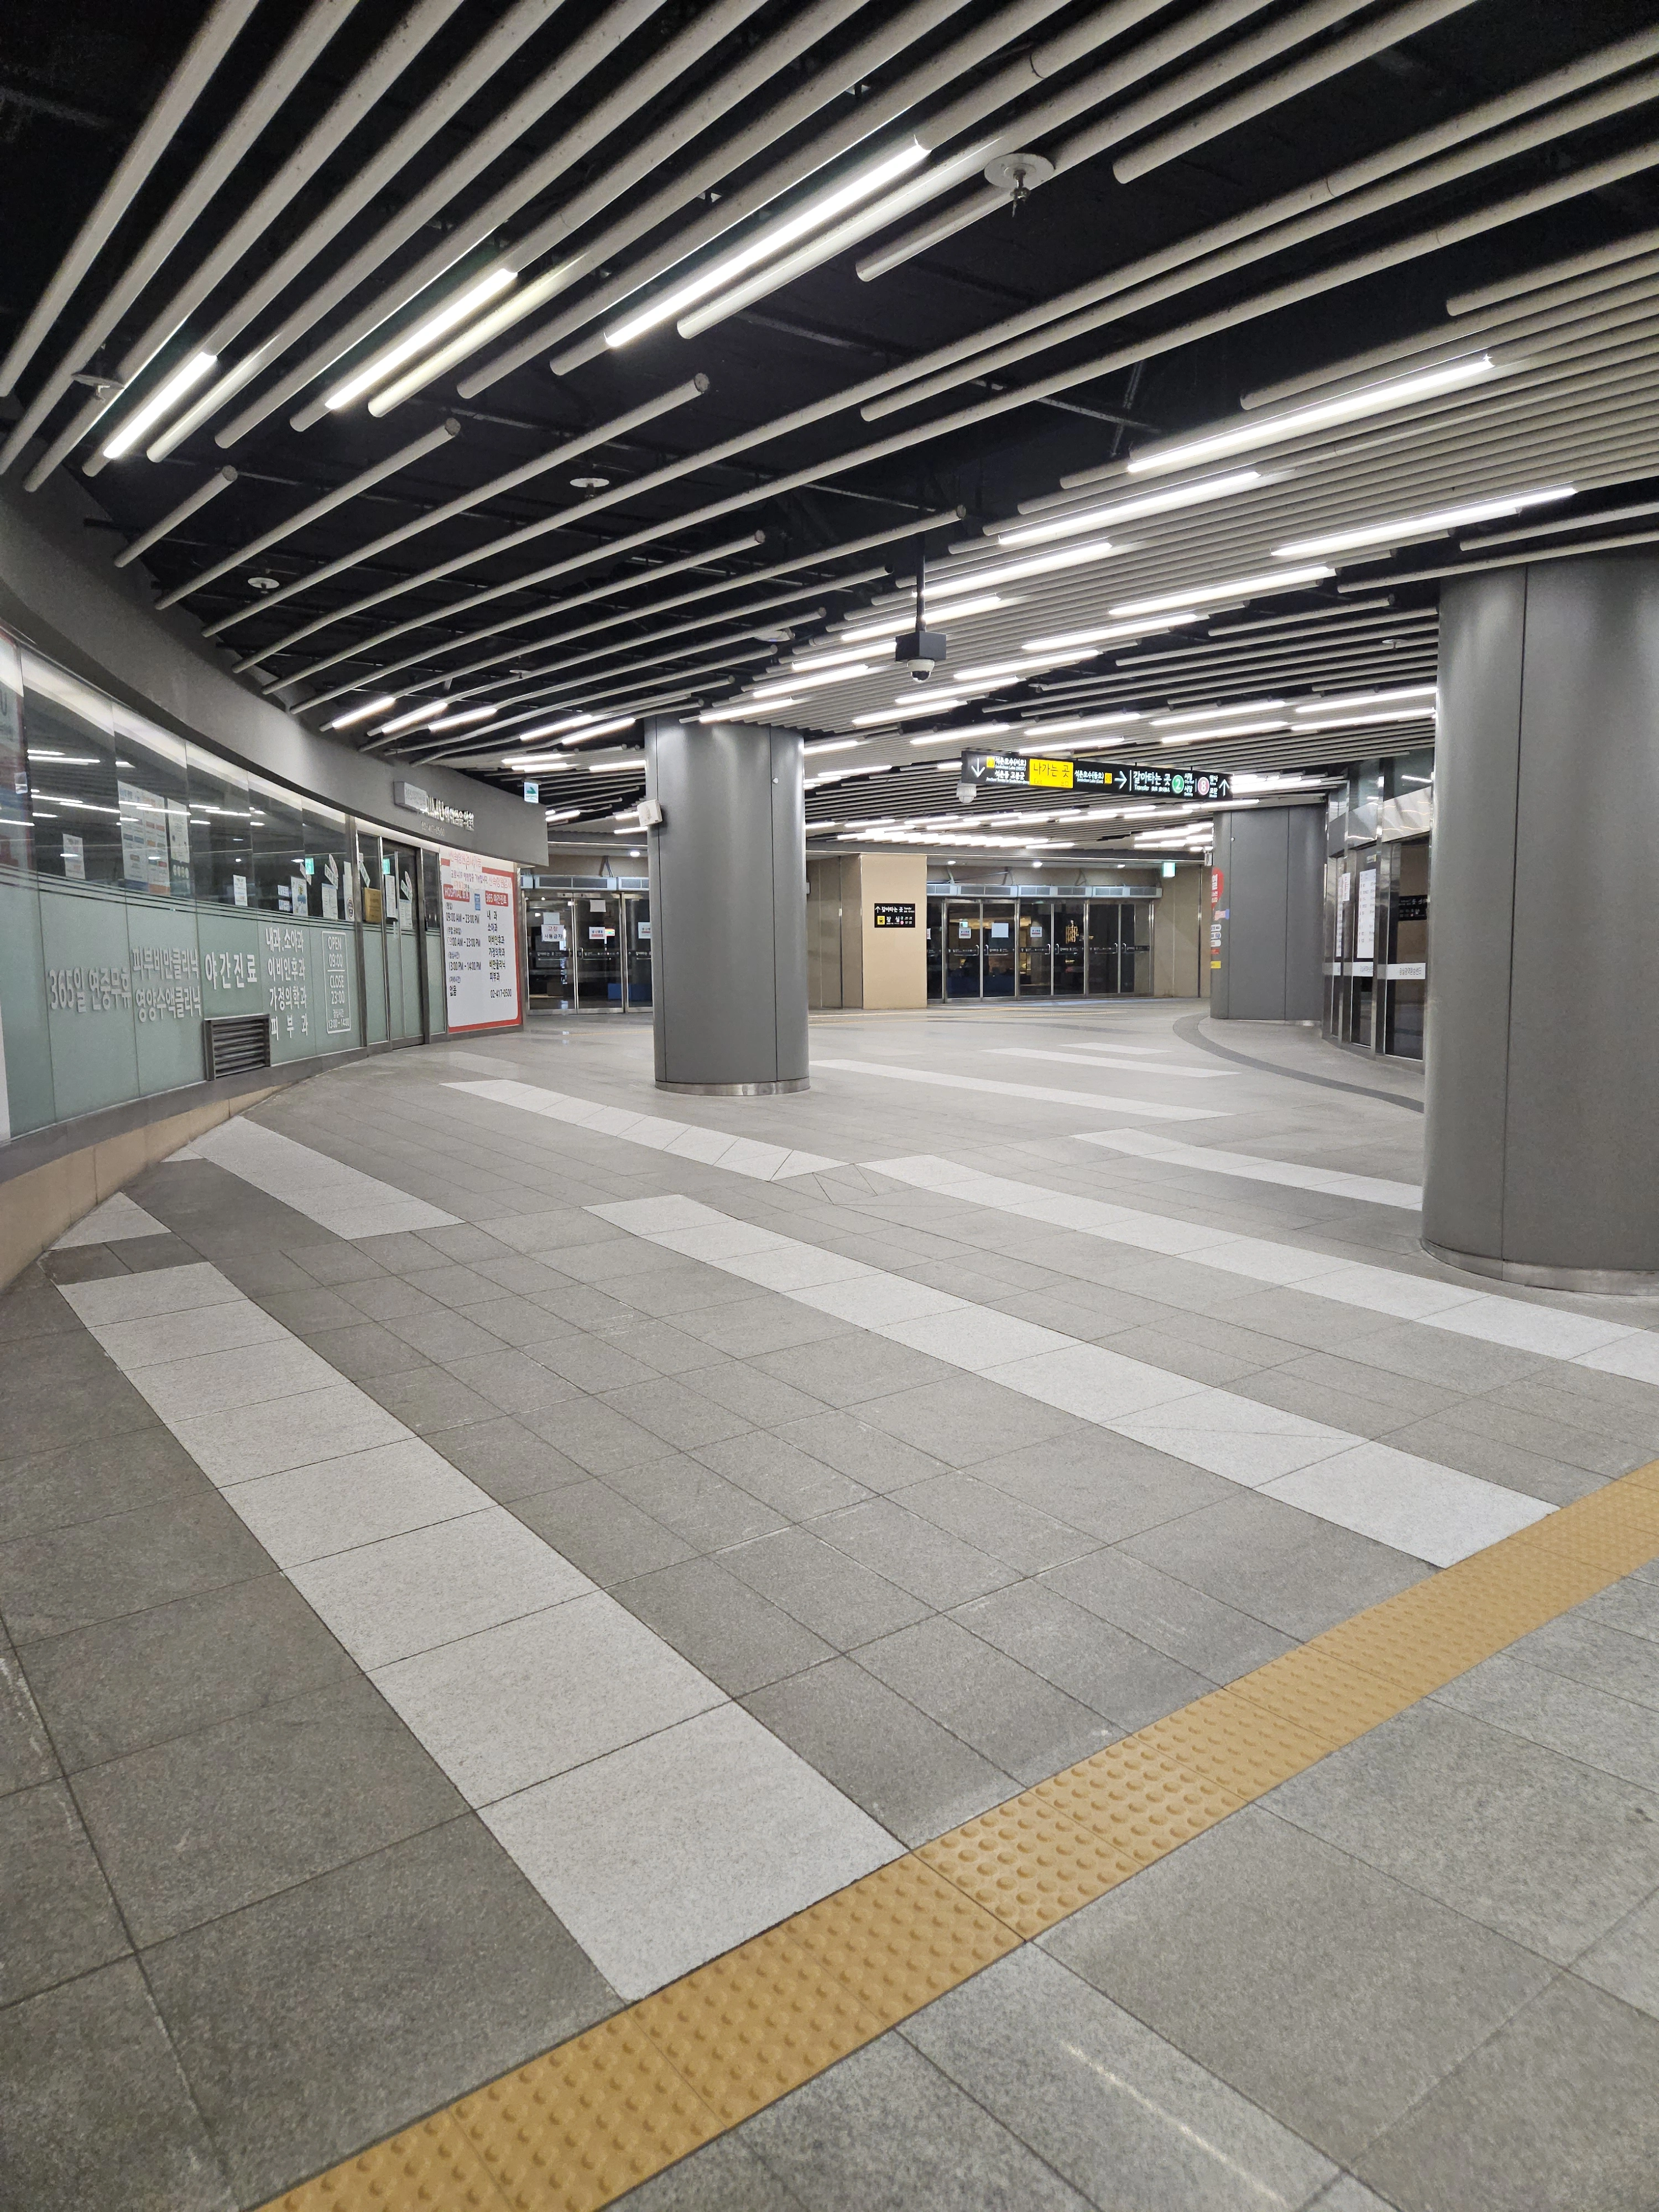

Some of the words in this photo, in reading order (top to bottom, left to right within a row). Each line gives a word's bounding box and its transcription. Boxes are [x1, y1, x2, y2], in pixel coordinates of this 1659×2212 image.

[1034, 761, 1058, 777] 나가는
[1062, 765, 1070, 778] 곳
[1133, 771, 1162, 785] 갈아타는
[1164, 773, 1171, 786] 곳
[1175, 778, 1181, 790] 2
[1201, 780, 1207, 791] 8
[456, 914, 462, 922] AM
[466, 914, 474, 923] 23:00
[474, 915, 480, 924] PM
[488, 922, 498, 933] 소아과
[328, 936, 342, 950] OPEN
[457, 938, 463, 946] AM
[467, 938, 475, 947] 23:00
[476, 938, 481, 947] PM
[488, 935, 505, 945] 이비인후과
[489, 947, 505, 957] 가정의학과
[132, 947, 199, 980] 피부비만클리닉
[329, 953, 343, 968] 09:00
[449, 962, 458, 971] 13:00
[458, 962, 463, 971] PM
[467, 962, 476, 971] 14:00
[476, 962, 481, 971] PM
[489, 959, 505, 969] 비만클리닉
[205, 952, 257, 990] 야간진료
[268, 957, 305, 982] 이비인후과
[330, 975, 344, 988] CLOSE
[490, 972, 500, 982] 피부과
[49, 967, 86, 1013] 365일
[88, 967, 132, 1010] 연중무휴
[450, 985, 457, 996] 없음
[491, 989, 512, 998] 02-417-0500
[269, 985, 307, 1011] 가정의학과
[331, 990, 345, 1004] 23:00
[136, 985, 201, 1022] 영양수액클리닉
